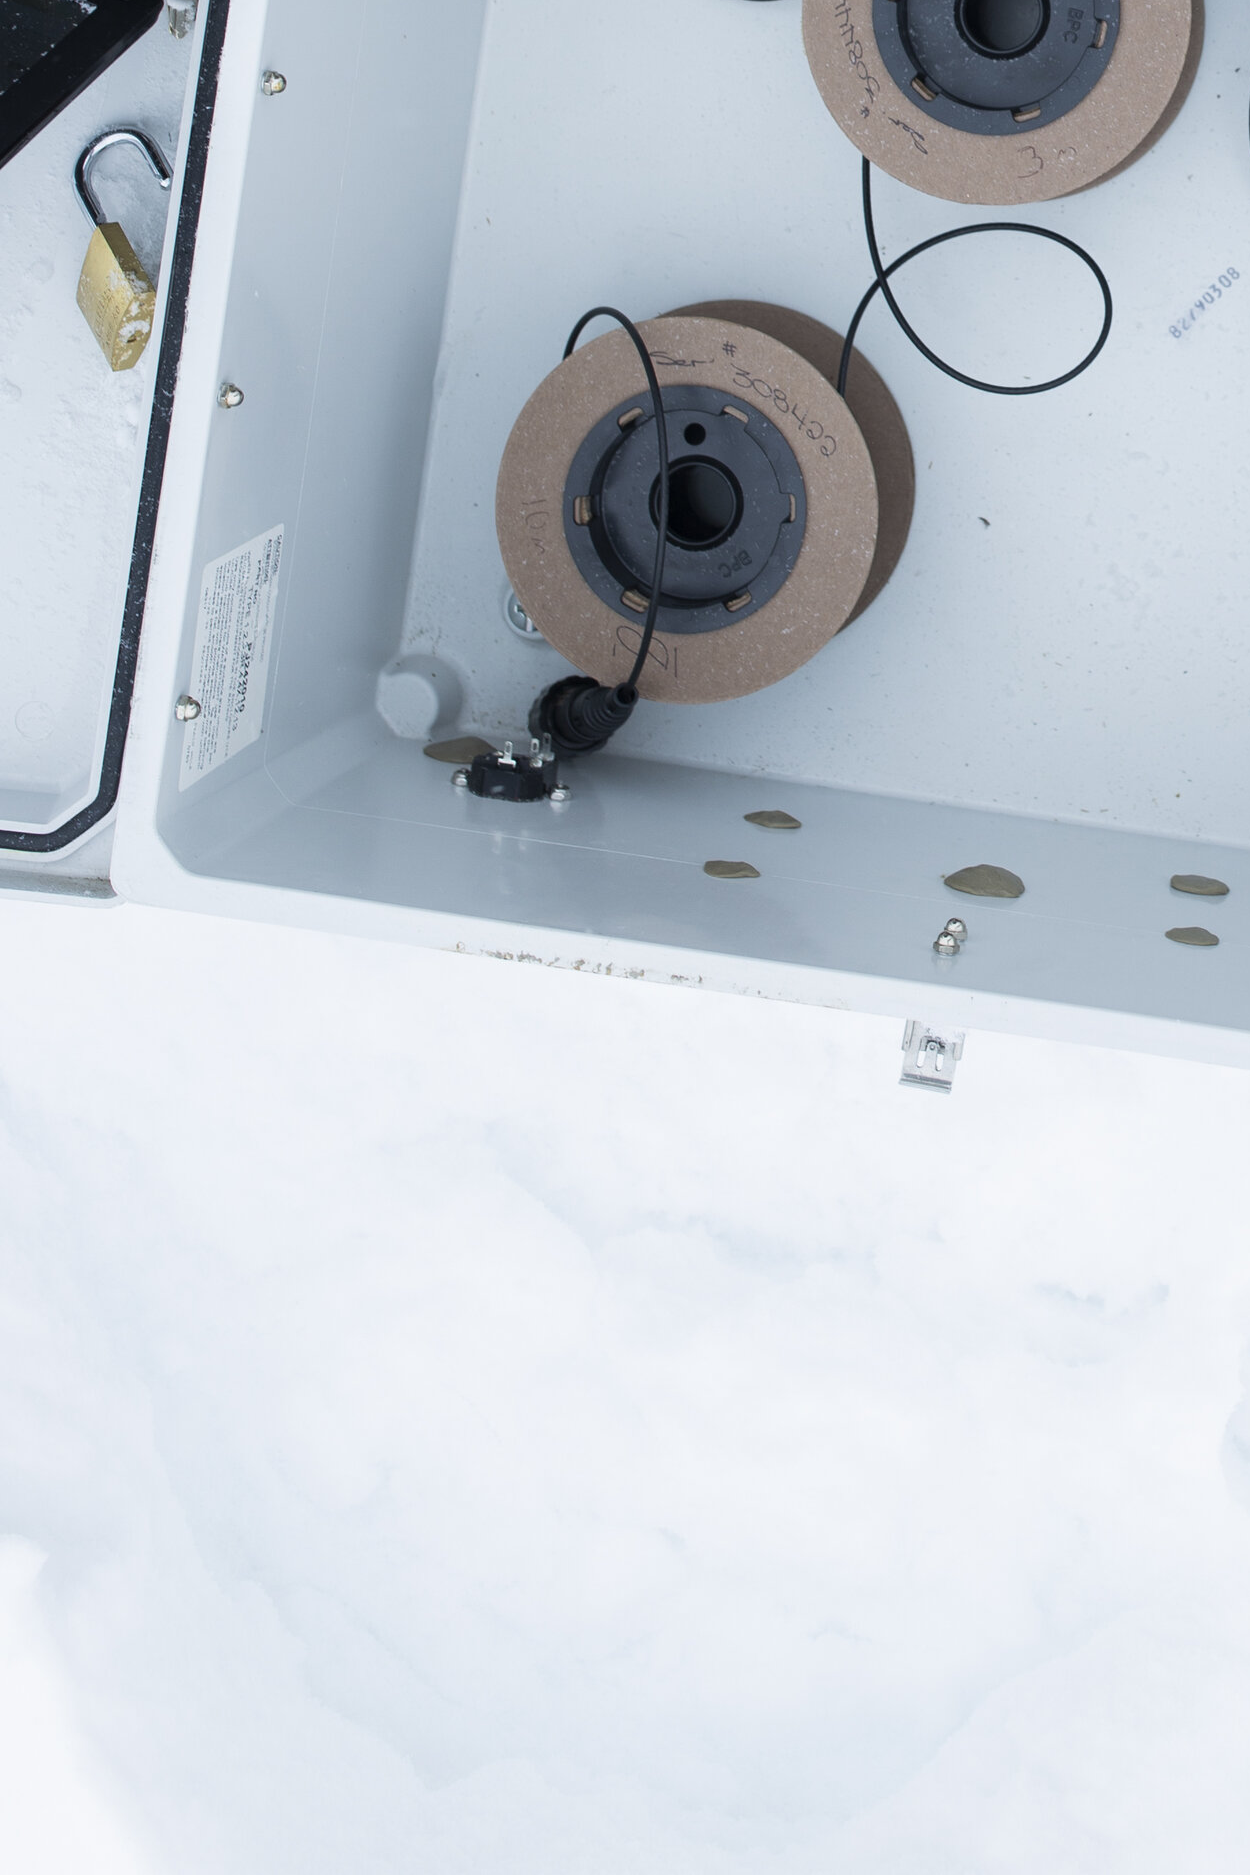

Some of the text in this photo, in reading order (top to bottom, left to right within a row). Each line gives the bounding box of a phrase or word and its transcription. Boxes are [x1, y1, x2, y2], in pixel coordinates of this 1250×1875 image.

[1064, 8, 1085, 45] BPC
[730, 363, 837, 458] 308422
[718, 549, 752, 579] BPC
